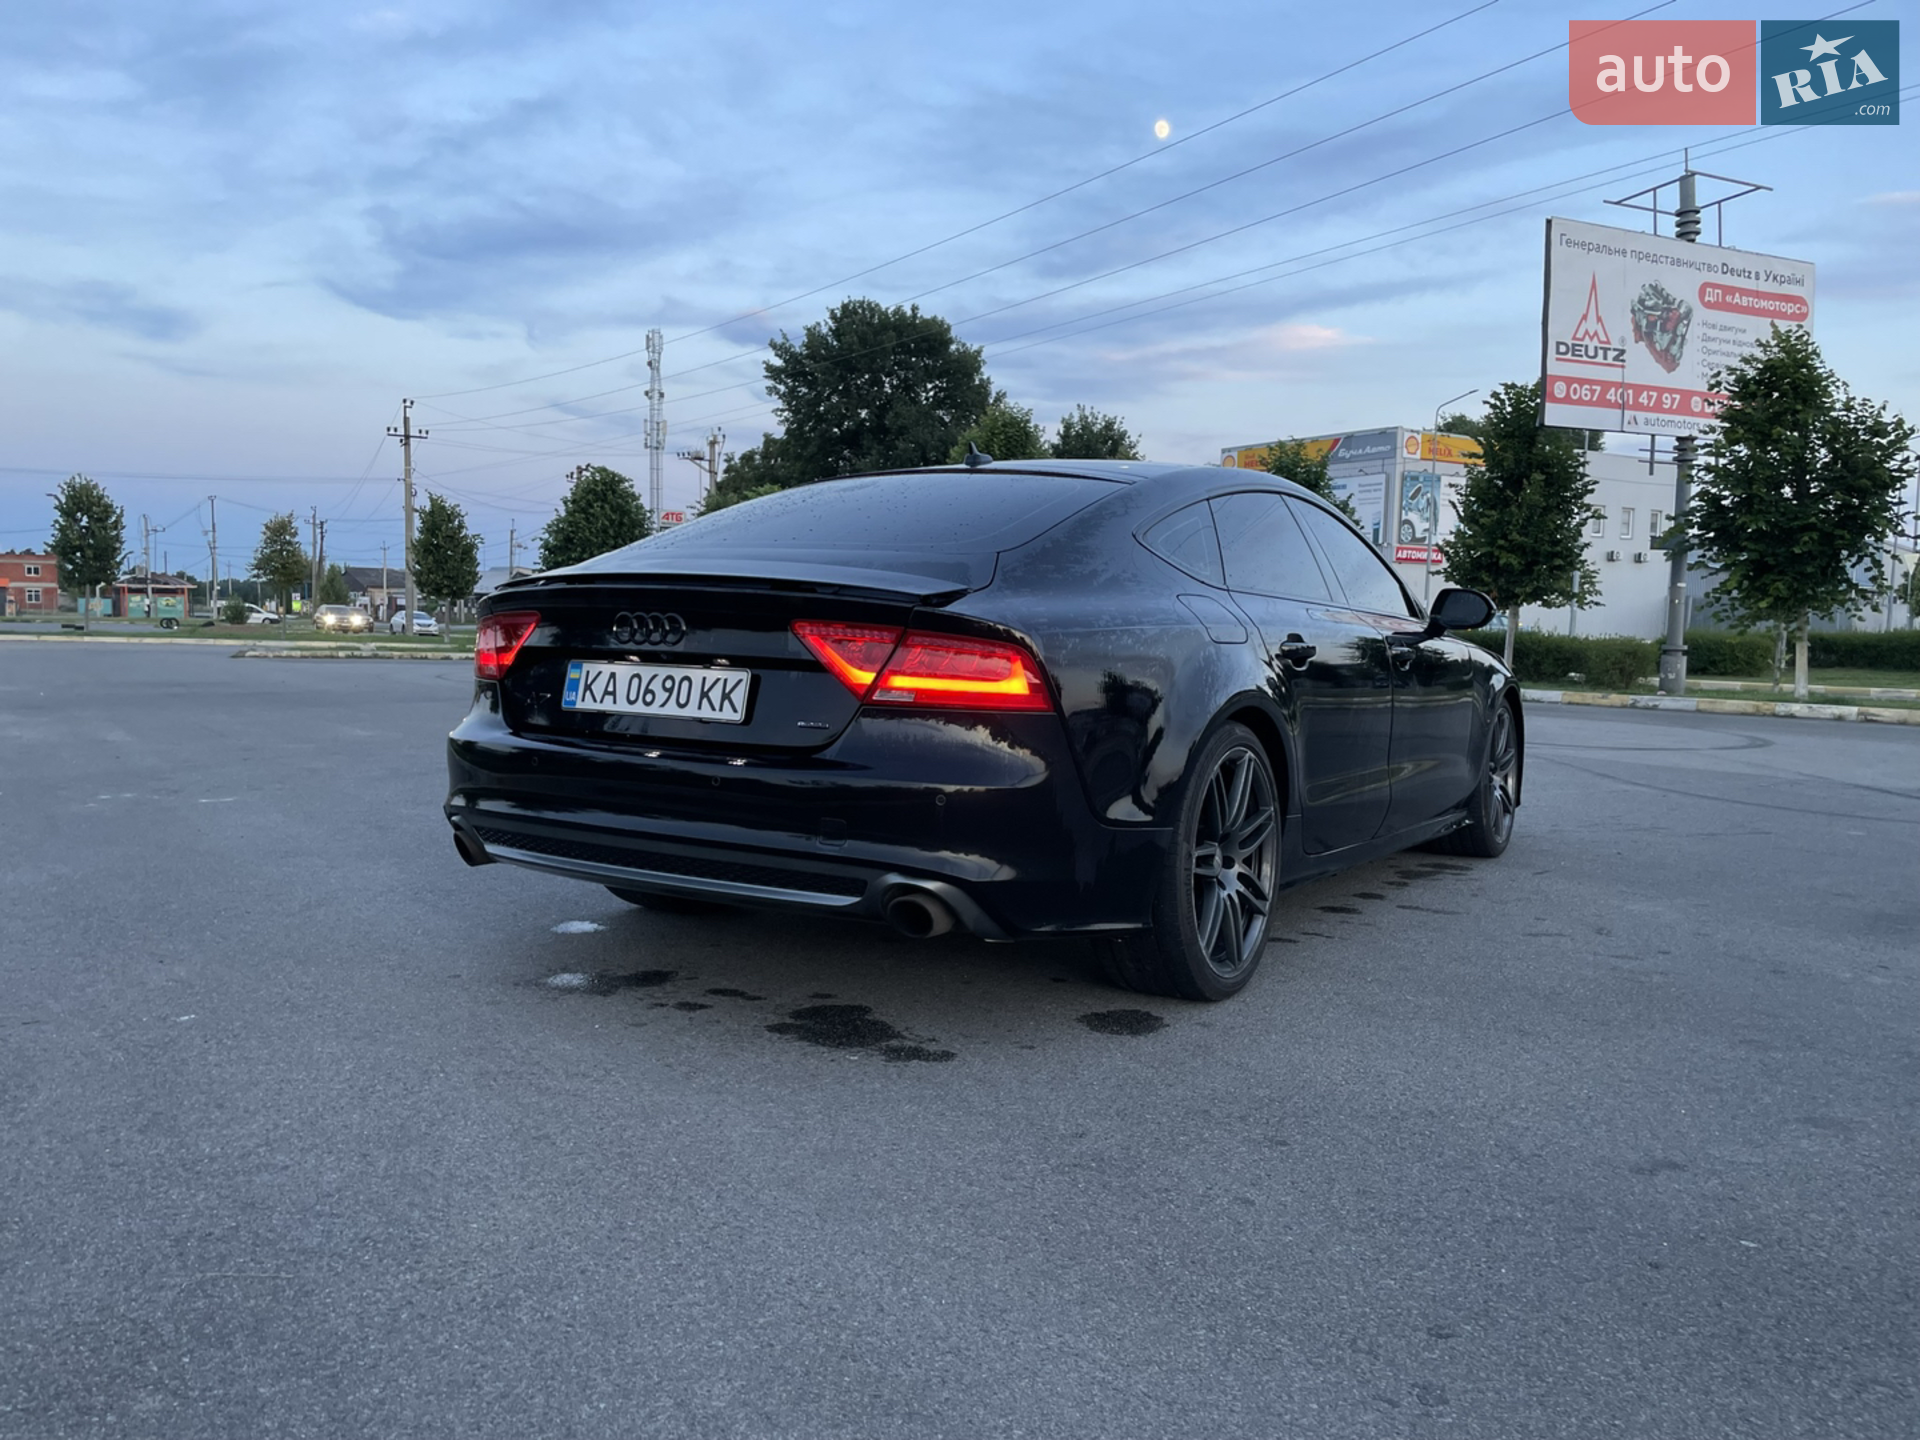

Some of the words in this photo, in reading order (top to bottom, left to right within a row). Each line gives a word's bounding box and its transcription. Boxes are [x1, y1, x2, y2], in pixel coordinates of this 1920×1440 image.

[1559, 233, 1627, 258] Генеральне
[1630, 249, 1720, 275] представництво
[1721, 262, 1753, 280] Deutz
[1763, 269, 1805, 287] Україні
[1704, 287, 1722, 303] ДП
[1725, 292, 1807, 315] «Автомоторс»
[1701, 332, 1731, 345] Двигуни
[1702, 320, 1718, 330] Нові
[1719, 323, 1747, 335] двигуни
[1555, 341, 1626, 363] DEUTZ
[1570, 384, 1602, 402] 067
[1606, 387, 1634, 406] 401
[1638, 391, 1658, 408] 47
[1662, 393, 1681, 410] 97
[1397, 549, 1442, 560] АВТОМИКА
[565, 691, 577, 701] UA
[581, 670, 618, 705] KA
[626, 672, 693, 709] 0690
[697, 676, 743, 714] KK
